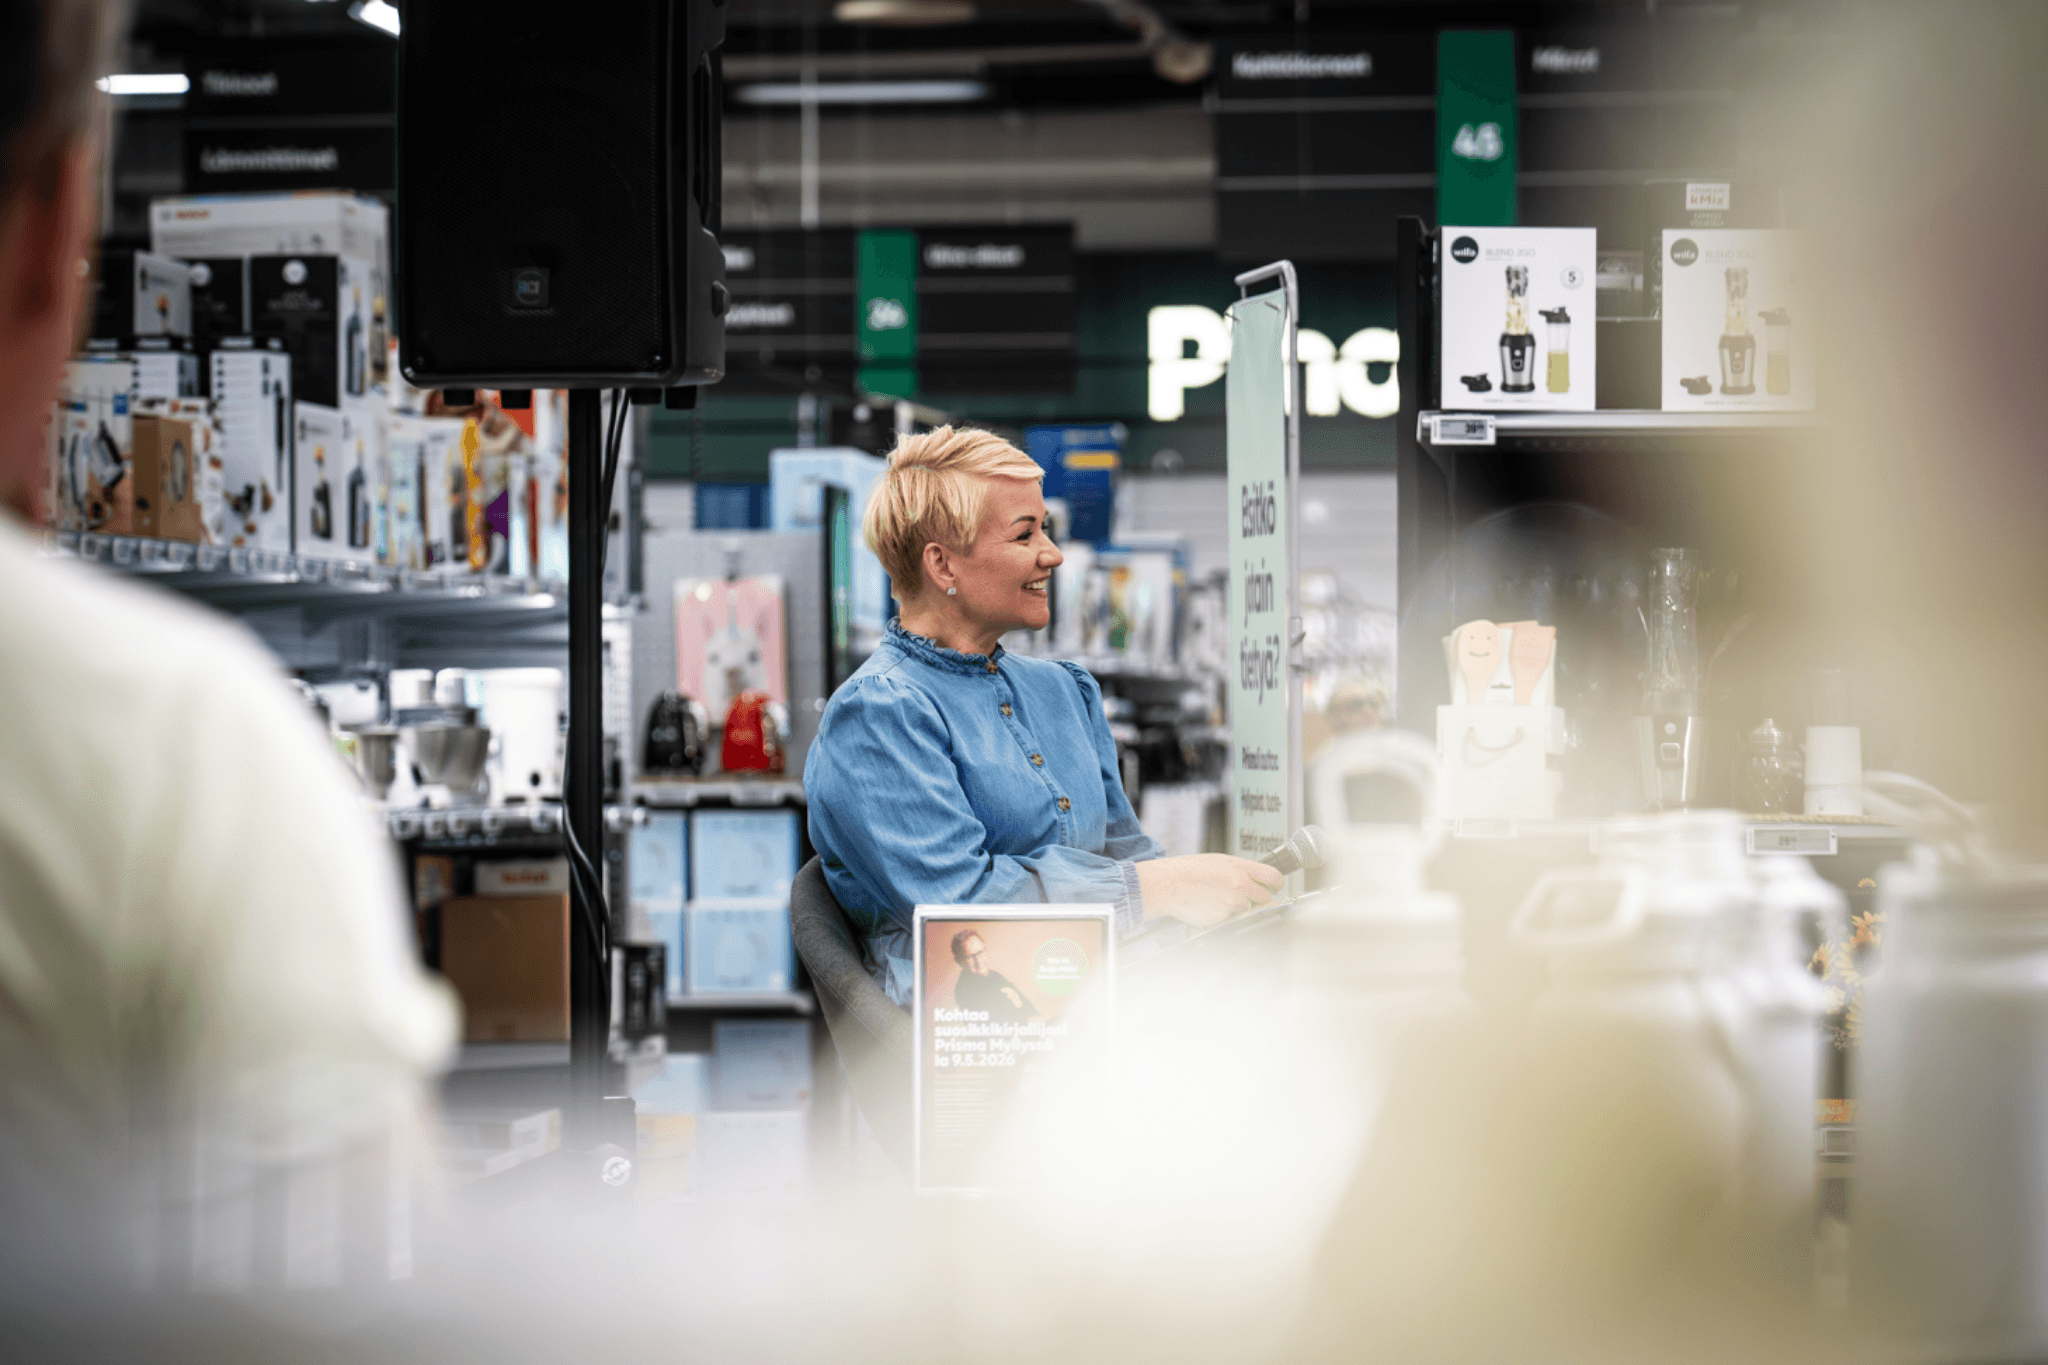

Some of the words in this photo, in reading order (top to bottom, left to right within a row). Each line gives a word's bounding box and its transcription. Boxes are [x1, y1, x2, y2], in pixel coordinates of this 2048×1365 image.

[1454, 247, 1477, 257] wilfa
[934, 1008, 990, 1022] Kohtaa
[934, 1038, 987, 1051] Prisma
[990, 1038, 1054, 1054] Myllyssä
[934, 1053, 949, 1067] la
[952, 1054, 1016, 1067] 9.5.2026
